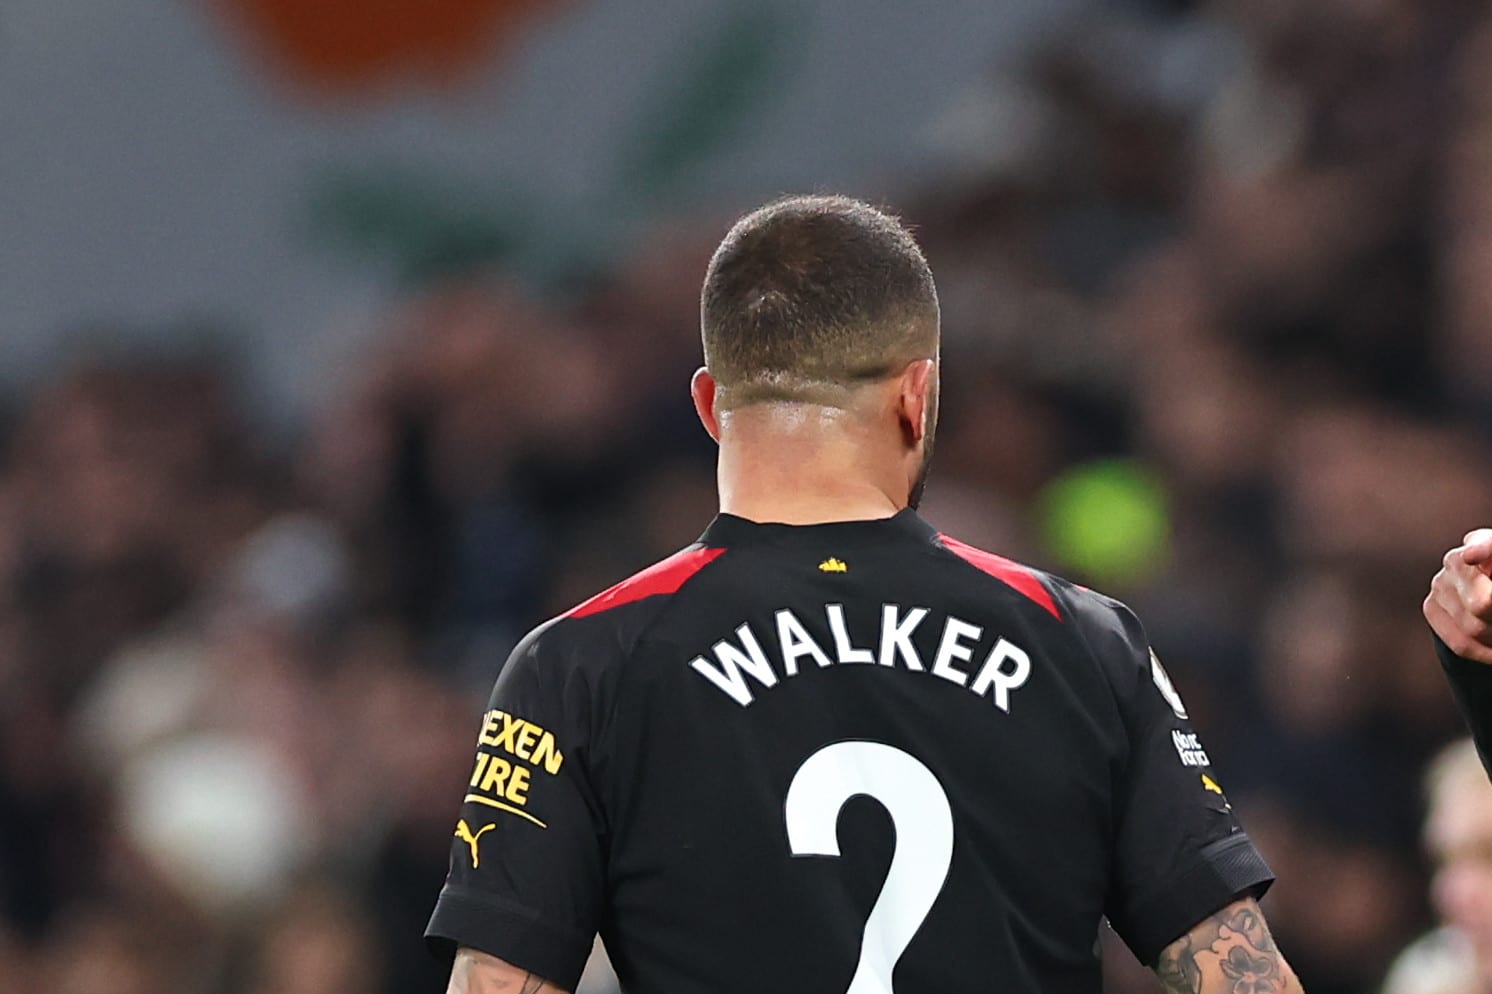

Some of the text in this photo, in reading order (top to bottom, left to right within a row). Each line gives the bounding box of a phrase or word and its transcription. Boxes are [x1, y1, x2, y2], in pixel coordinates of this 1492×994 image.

[688, 602, 1034, 714] WALKER
[477, 709, 564, 775] EXEN
[469, 751, 531, 806] IRE
